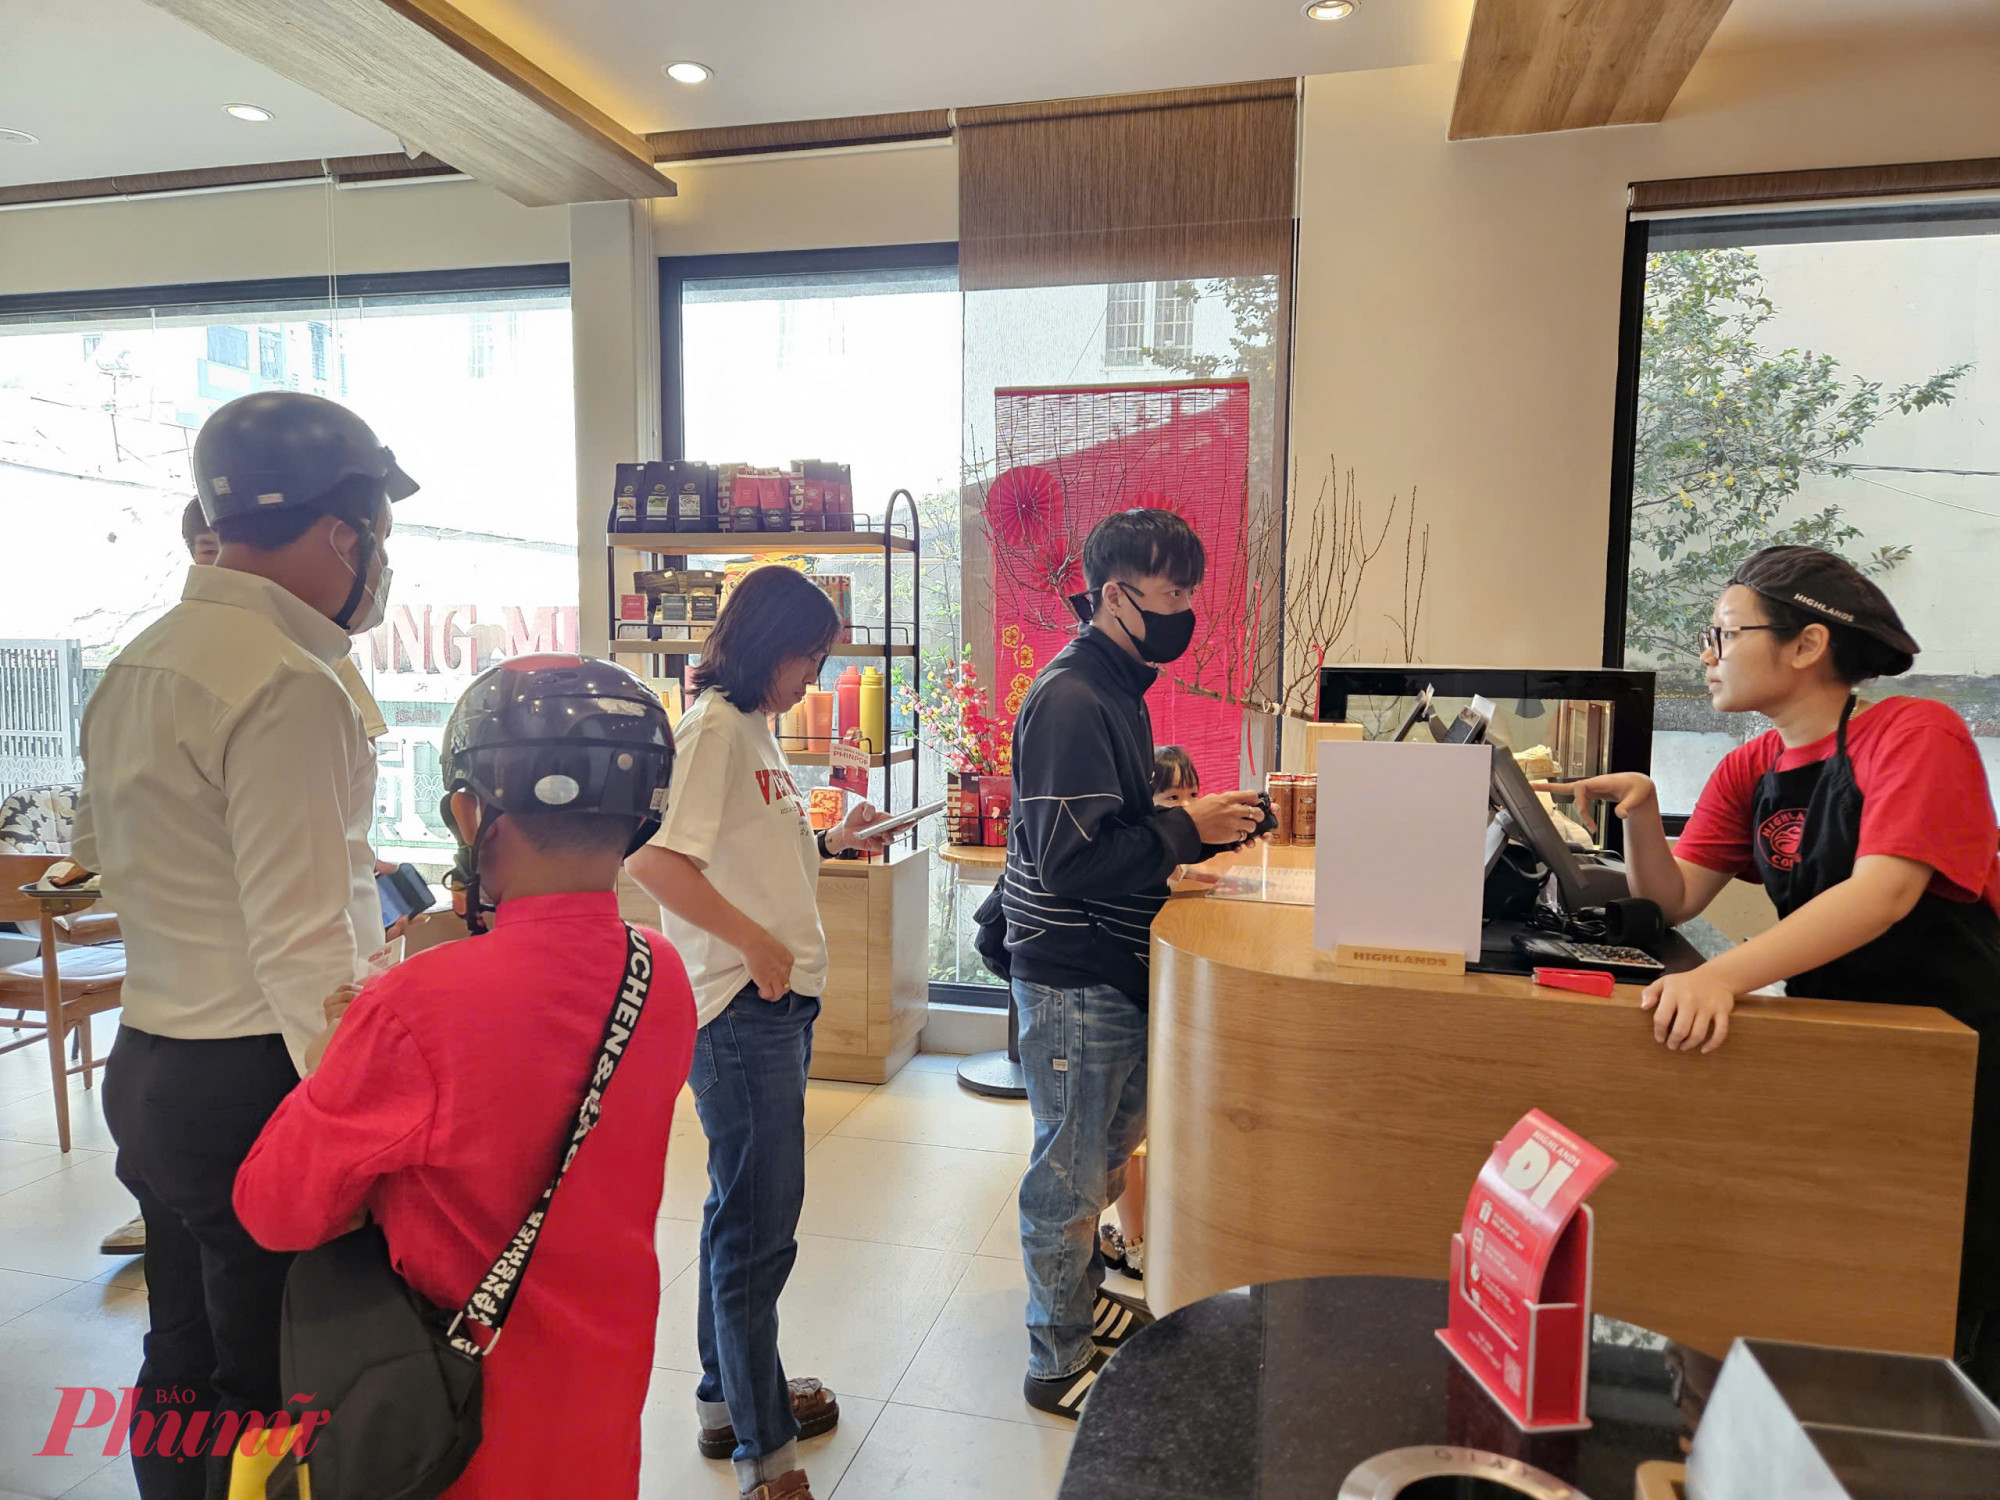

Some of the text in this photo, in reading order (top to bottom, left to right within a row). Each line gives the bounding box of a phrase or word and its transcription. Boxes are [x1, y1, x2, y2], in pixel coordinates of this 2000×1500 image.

[1793, 592, 1856, 623] HIGHLANDS
[1353, 951, 1448, 967] HIGHLANDS
[1532, 1129, 1582, 1169] HIGHLANDS
